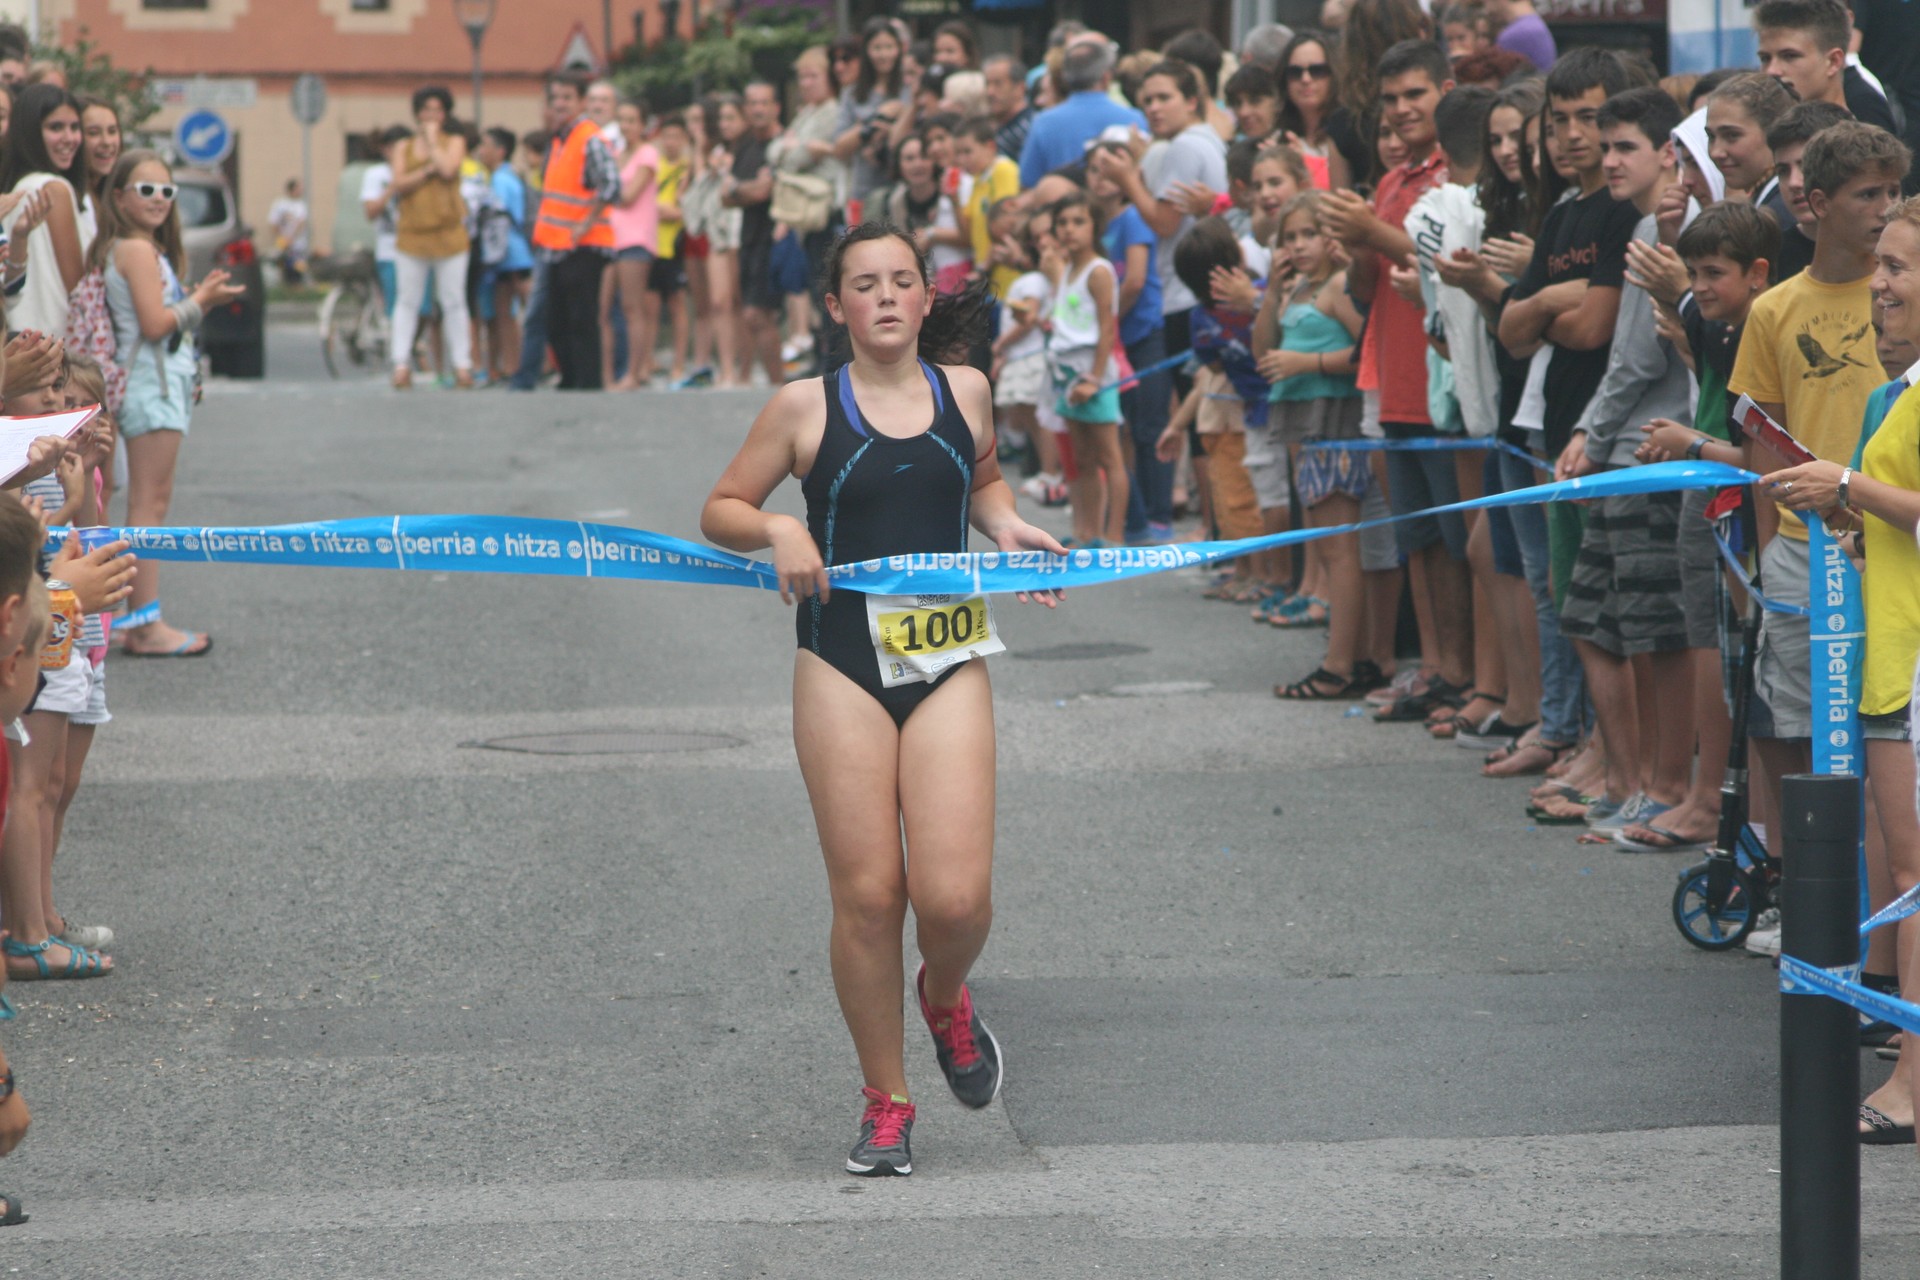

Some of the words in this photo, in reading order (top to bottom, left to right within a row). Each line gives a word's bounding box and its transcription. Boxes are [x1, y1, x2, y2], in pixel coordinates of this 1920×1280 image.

[118, 529, 178, 550] hitza
[208, 529, 284, 553] berria
[310, 531, 371, 553] hitza
[401, 531, 477, 556] berria
[504, 532, 561, 558] hitza
[889, 553, 971, 577] berria
[1007, 550, 1068, 574] hitza
[1097, 550, 1177, 574] berria
[1824, 544, 1848, 607] hitza
[900, 605, 972, 652] 100
[1828, 642, 1854, 722] berria
